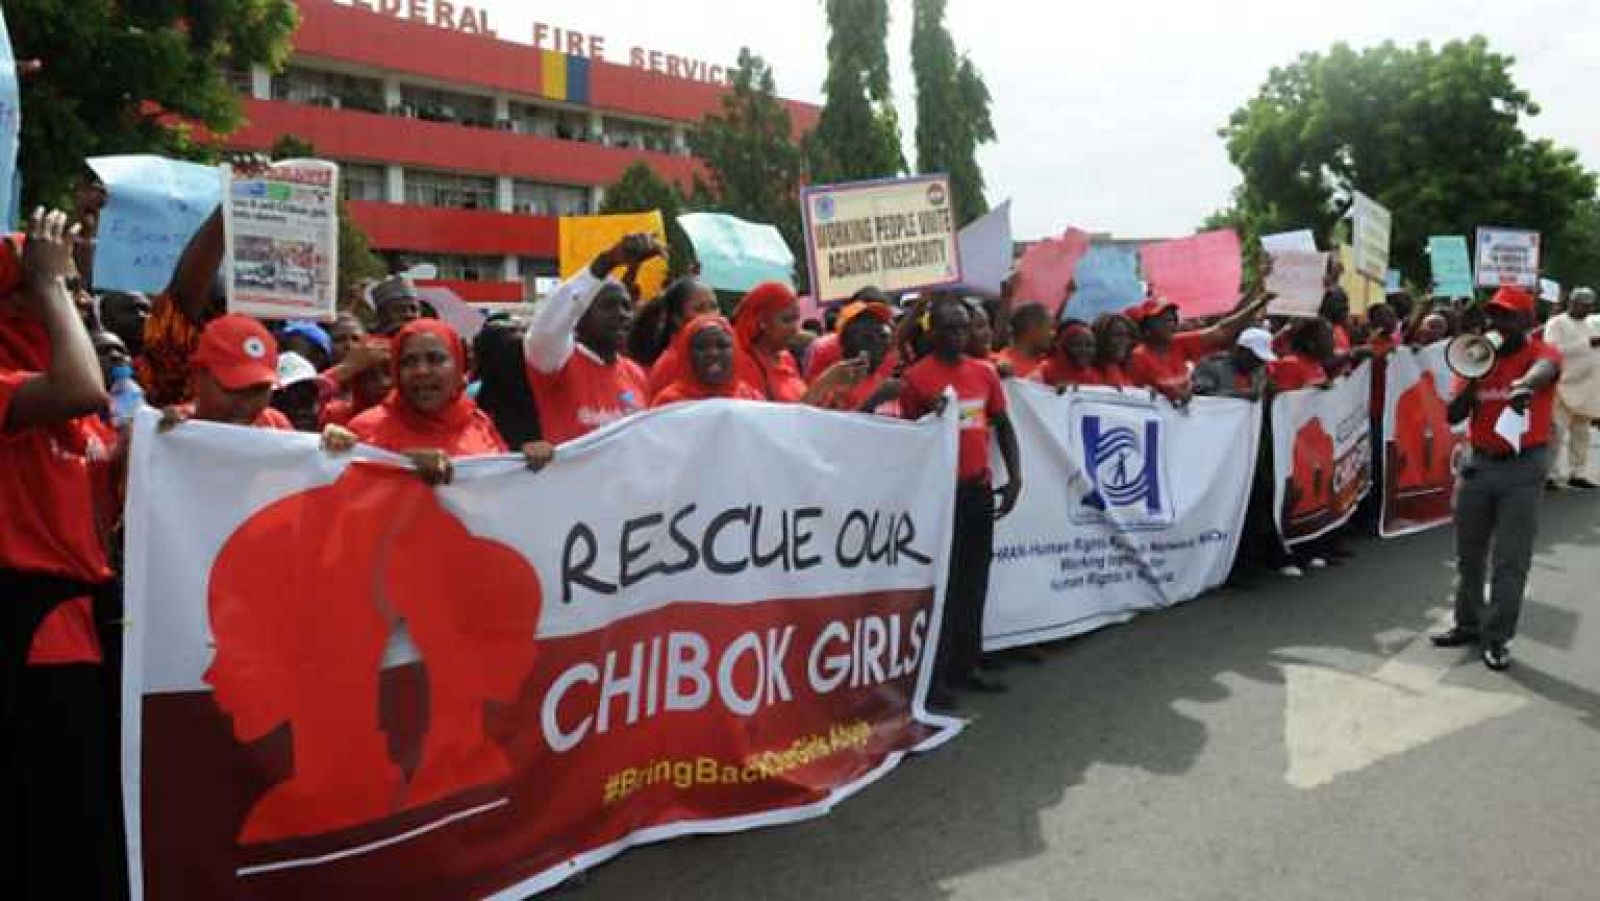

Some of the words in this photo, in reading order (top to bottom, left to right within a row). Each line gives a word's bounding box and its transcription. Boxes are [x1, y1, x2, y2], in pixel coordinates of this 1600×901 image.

[332, 0, 497, 38] DERAL
[532, 21, 605, 59] FIRE
[816, 217, 874, 248] WORKING
[875, 212, 917, 240] PEOPLE
[829, 247, 876, 279] AGAINST
[879, 238, 946, 269] INSECURITY
[561, 502, 822, 604] RESCUE
[836, 508, 932, 569] OUR
[540, 623, 795, 753] CHIBOK
[806, 609, 929, 695] GIRLS
